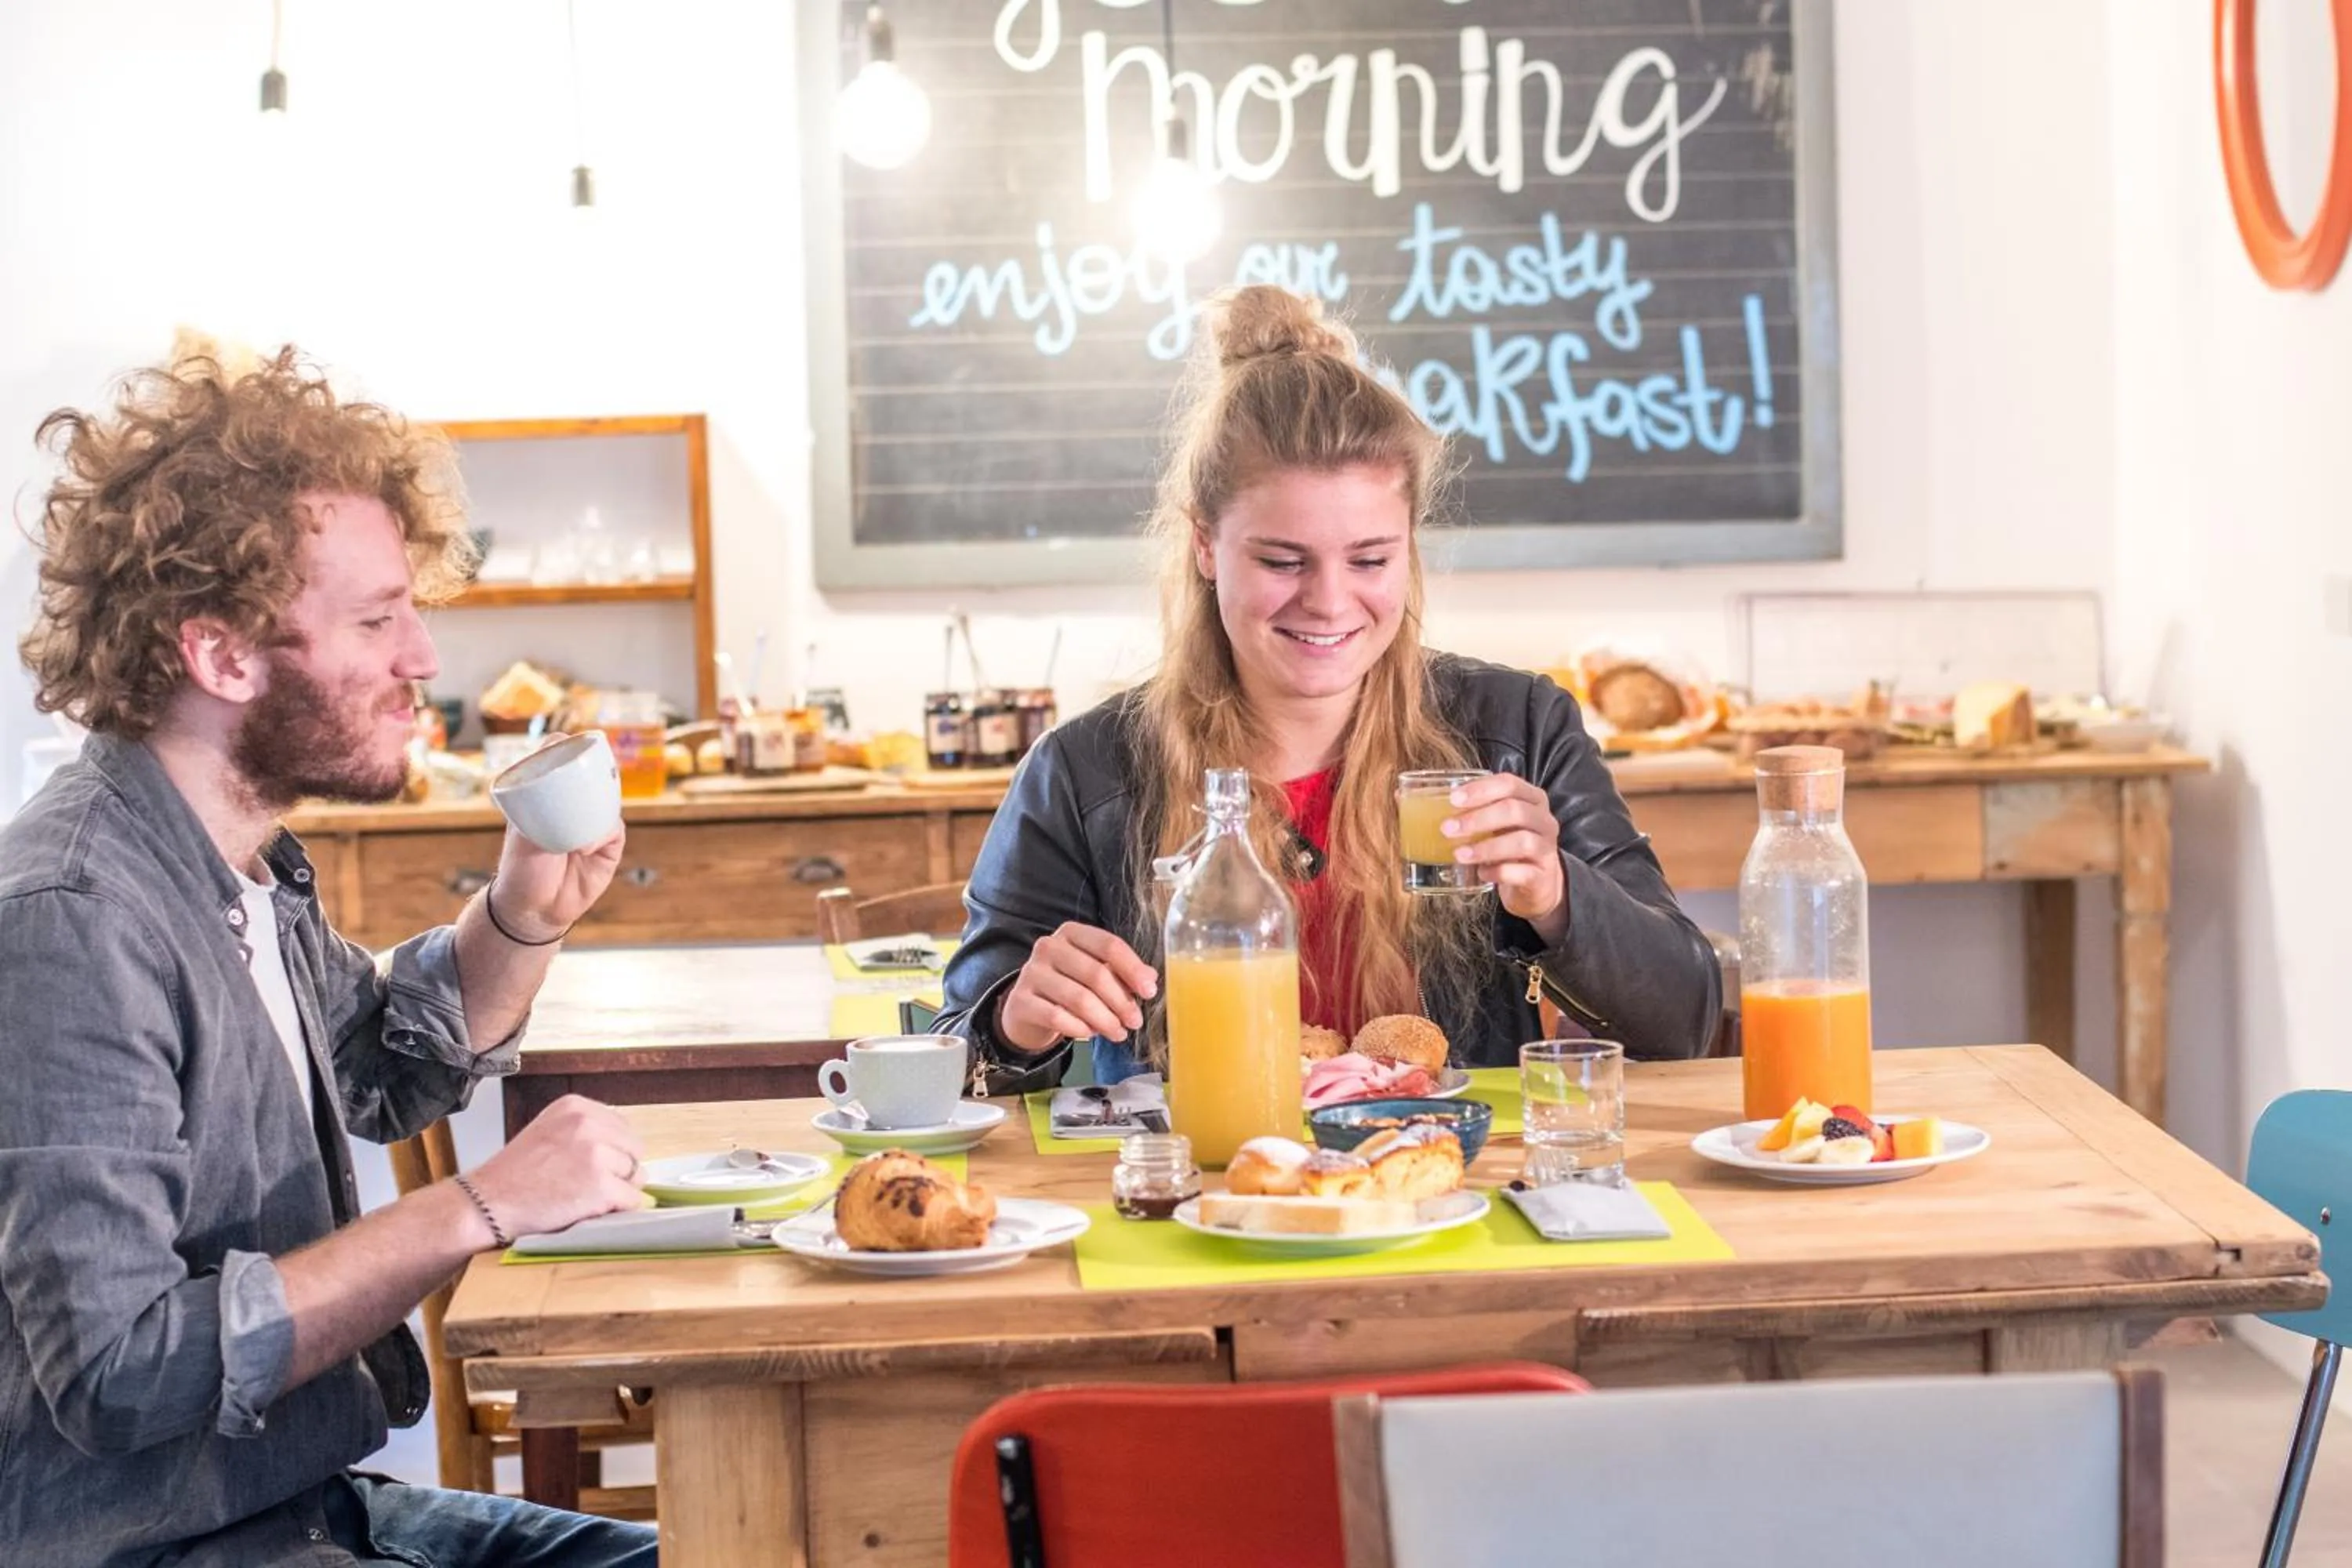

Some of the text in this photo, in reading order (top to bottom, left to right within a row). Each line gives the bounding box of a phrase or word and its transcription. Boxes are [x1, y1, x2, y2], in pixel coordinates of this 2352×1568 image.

[1081, 27, 1727, 223] morning
[908, 201, 1654, 361] enjoy our tasty
[1355, 293, 1773, 482] akfast!
